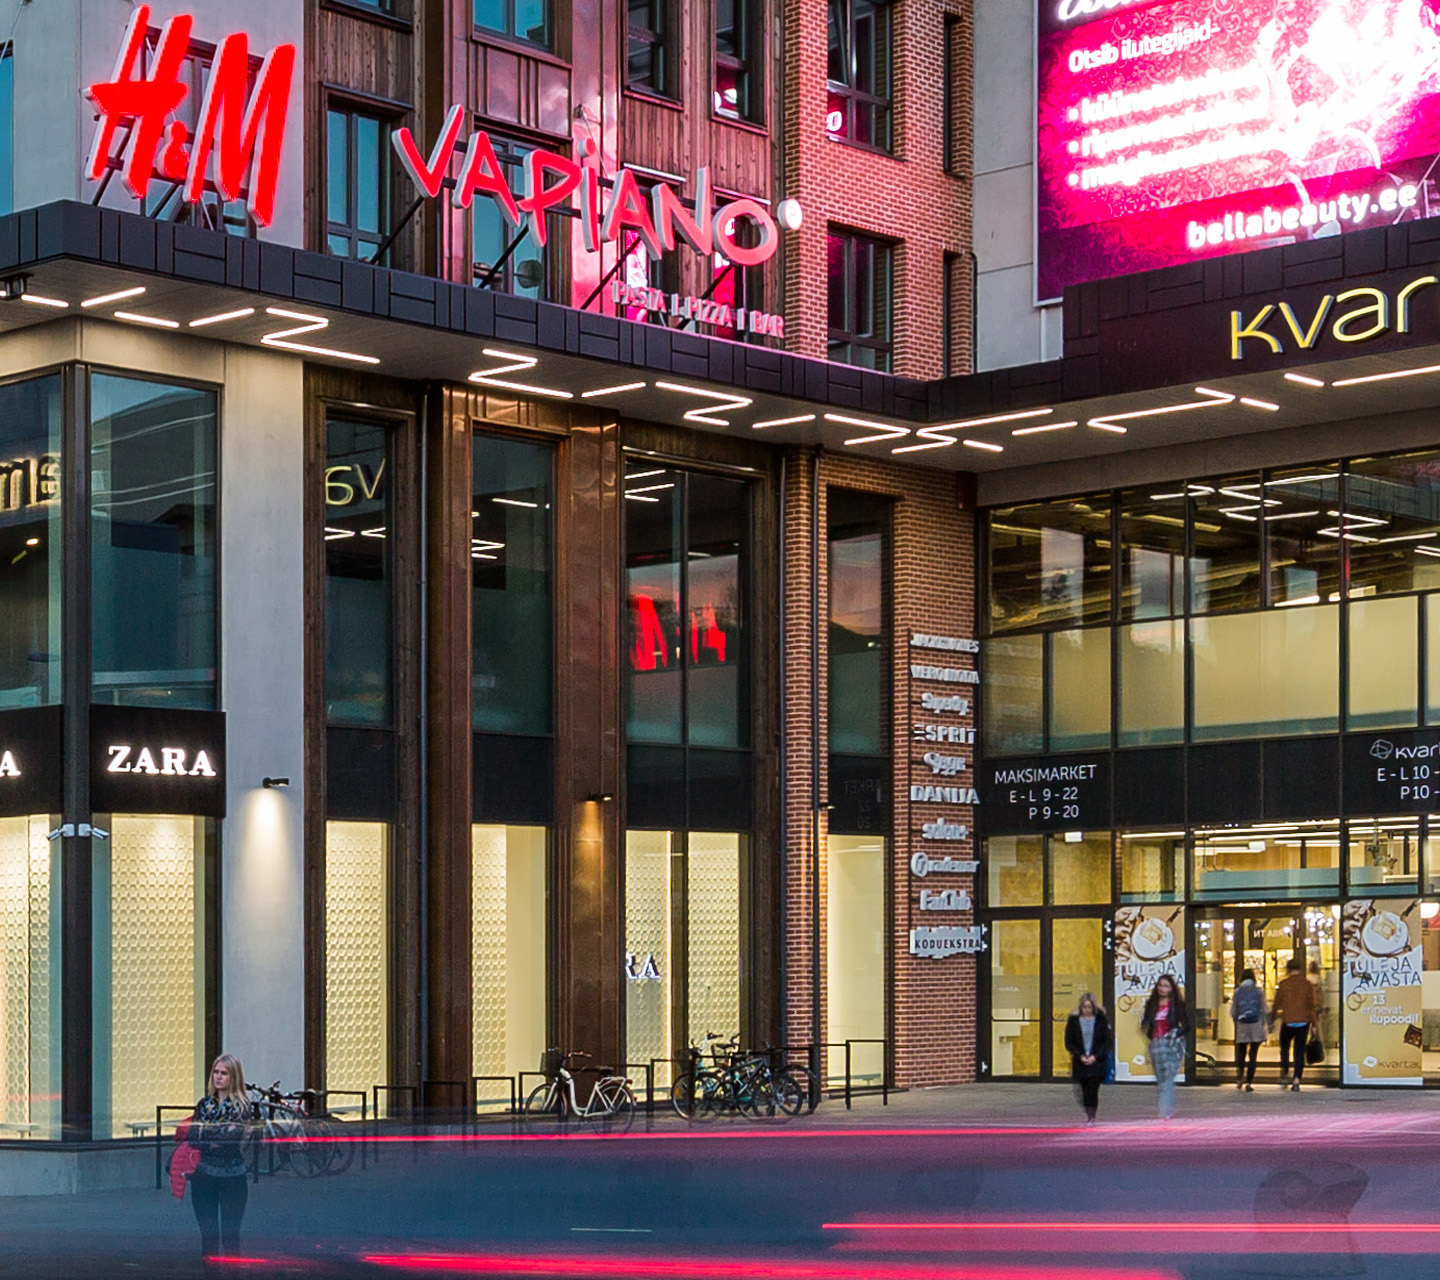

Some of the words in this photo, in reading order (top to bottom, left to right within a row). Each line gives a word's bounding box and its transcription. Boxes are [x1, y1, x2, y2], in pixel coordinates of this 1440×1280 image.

[1069, 48, 1119, 73] Otsib
[85, 4, 295, 227] H&M
[1188, 184, 1417, 248] bellabeauty.ee
[612, 280, 666, 313] PASTA
[684, 296, 733, 328] PIZZA
[749, 309, 785, 339] BAR
[913, 724, 977, 744] ESPRIT
[107, 744, 216, 777] ZARA
[995, 764, 1097, 784] MAKSIMARKET
[910, 785, 980, 804] DANIJA
[915, 938, 981, 950] KODUEKSTRA
[1358, 970, 1422, 987] AVASTA
